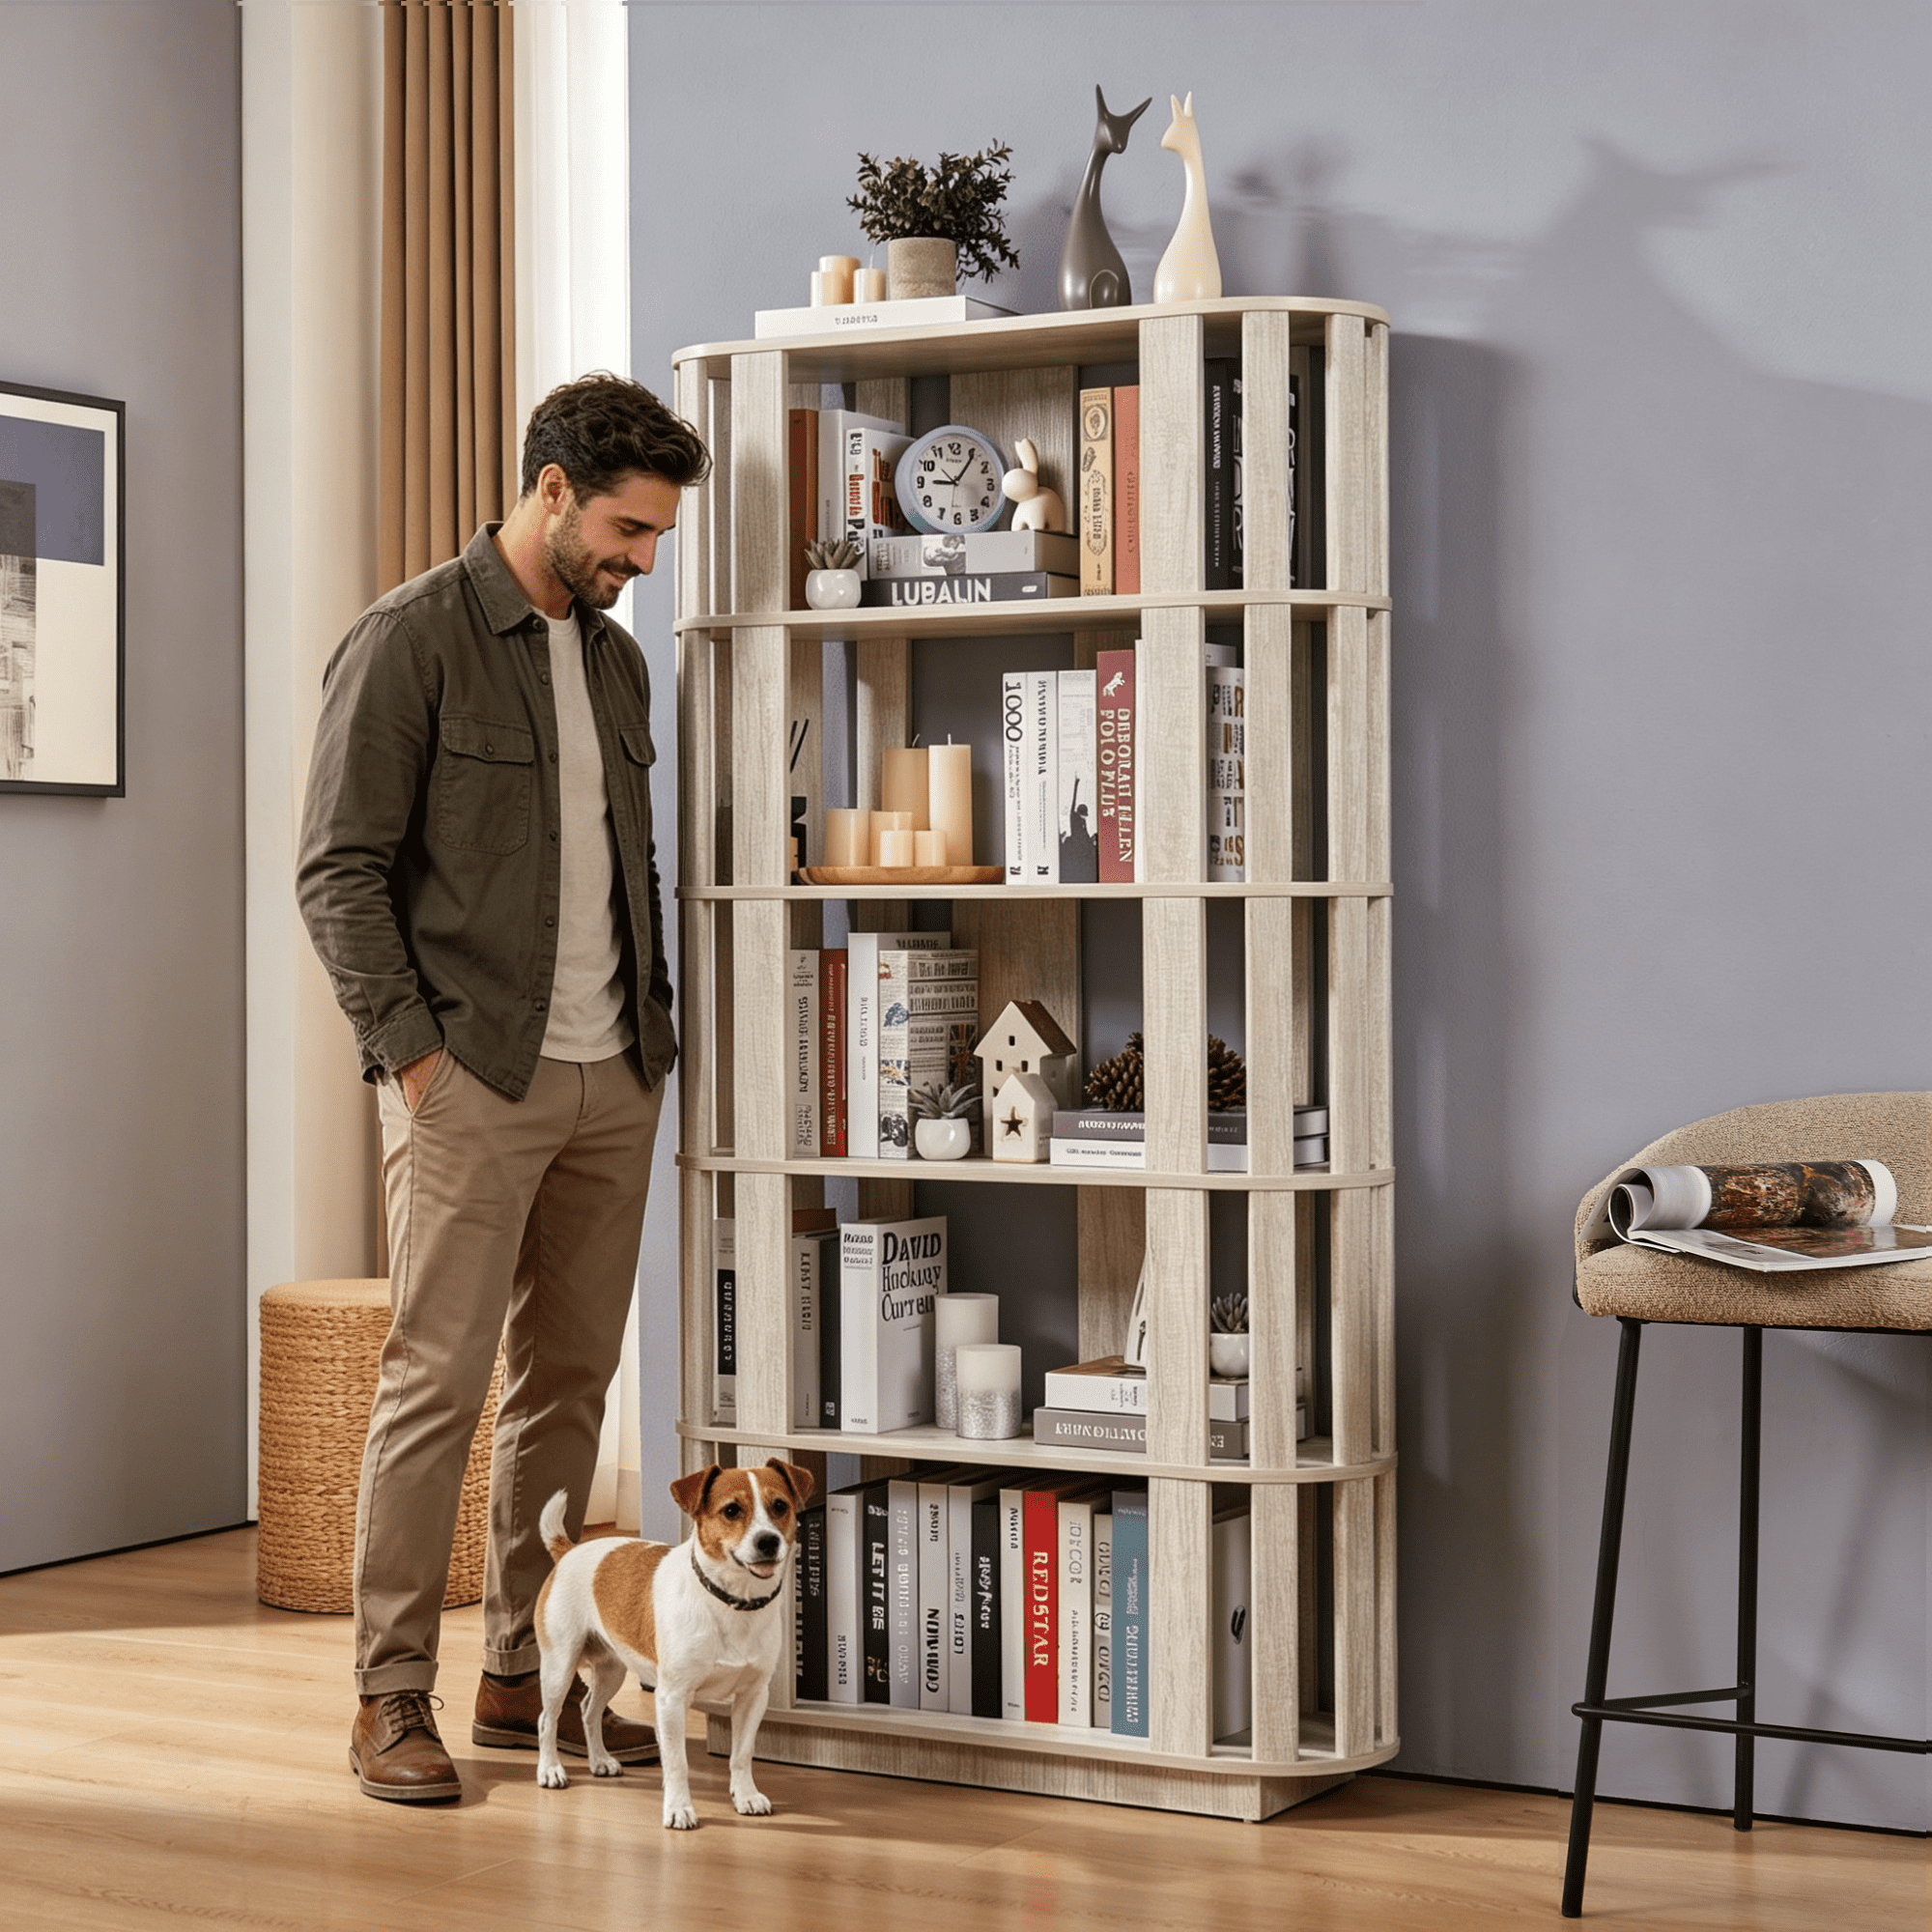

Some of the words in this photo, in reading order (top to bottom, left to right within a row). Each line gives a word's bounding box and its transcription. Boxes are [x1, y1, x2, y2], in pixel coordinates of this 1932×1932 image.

[917, 475, 924, 489] 9
[892, 578, 991, 606] LUBALIN
[1006, 681, 1023, 742] 1000
[882, 1231, 942, 1265] DAVID
[871, 1542, 885, 1578] LET
[871, 1581, 885, 1602] IT
